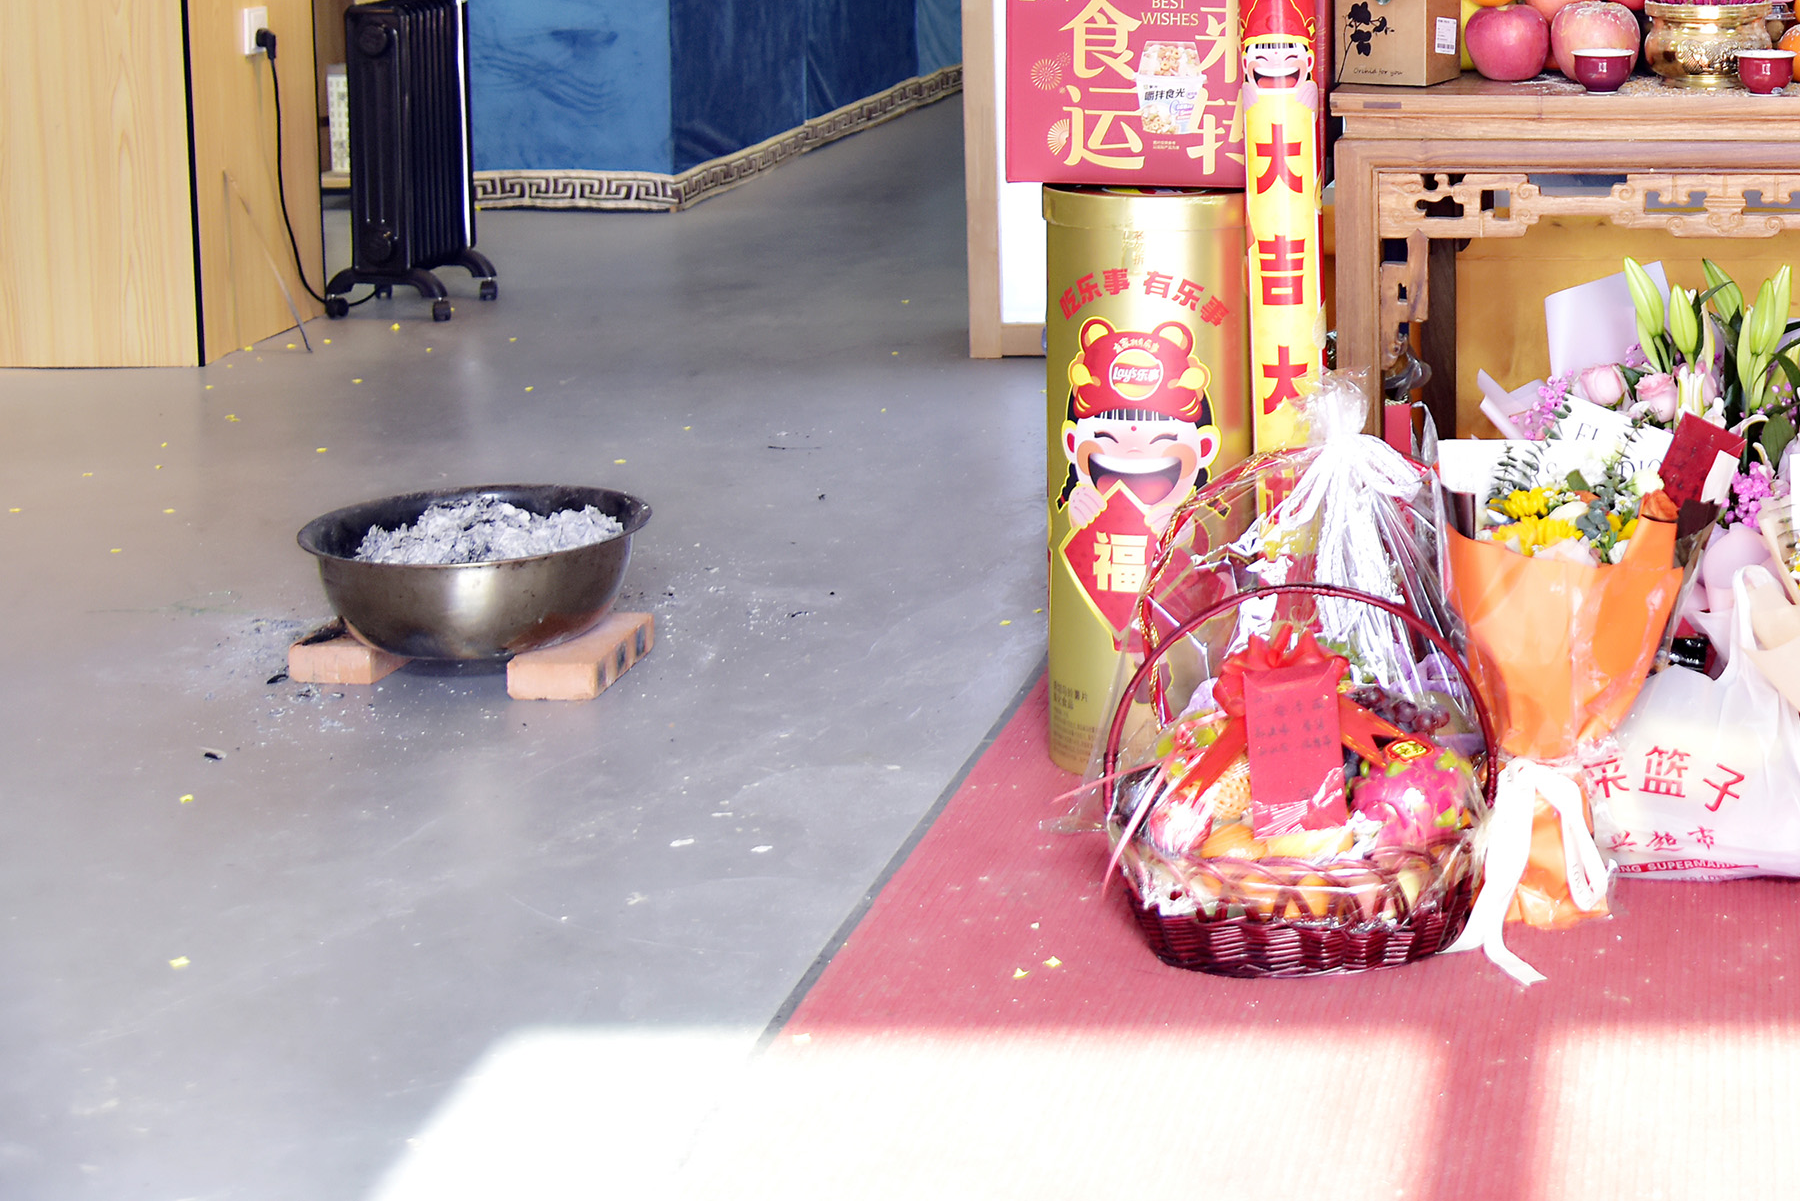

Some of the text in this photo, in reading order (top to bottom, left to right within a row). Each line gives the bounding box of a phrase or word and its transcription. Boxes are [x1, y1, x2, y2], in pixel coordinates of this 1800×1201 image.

[1141, 11, 1199, 26] WISHES
[1058, 268, 1230, 327] 吃乐事 有乐事
[1092, 531, 1149, 593] 福
